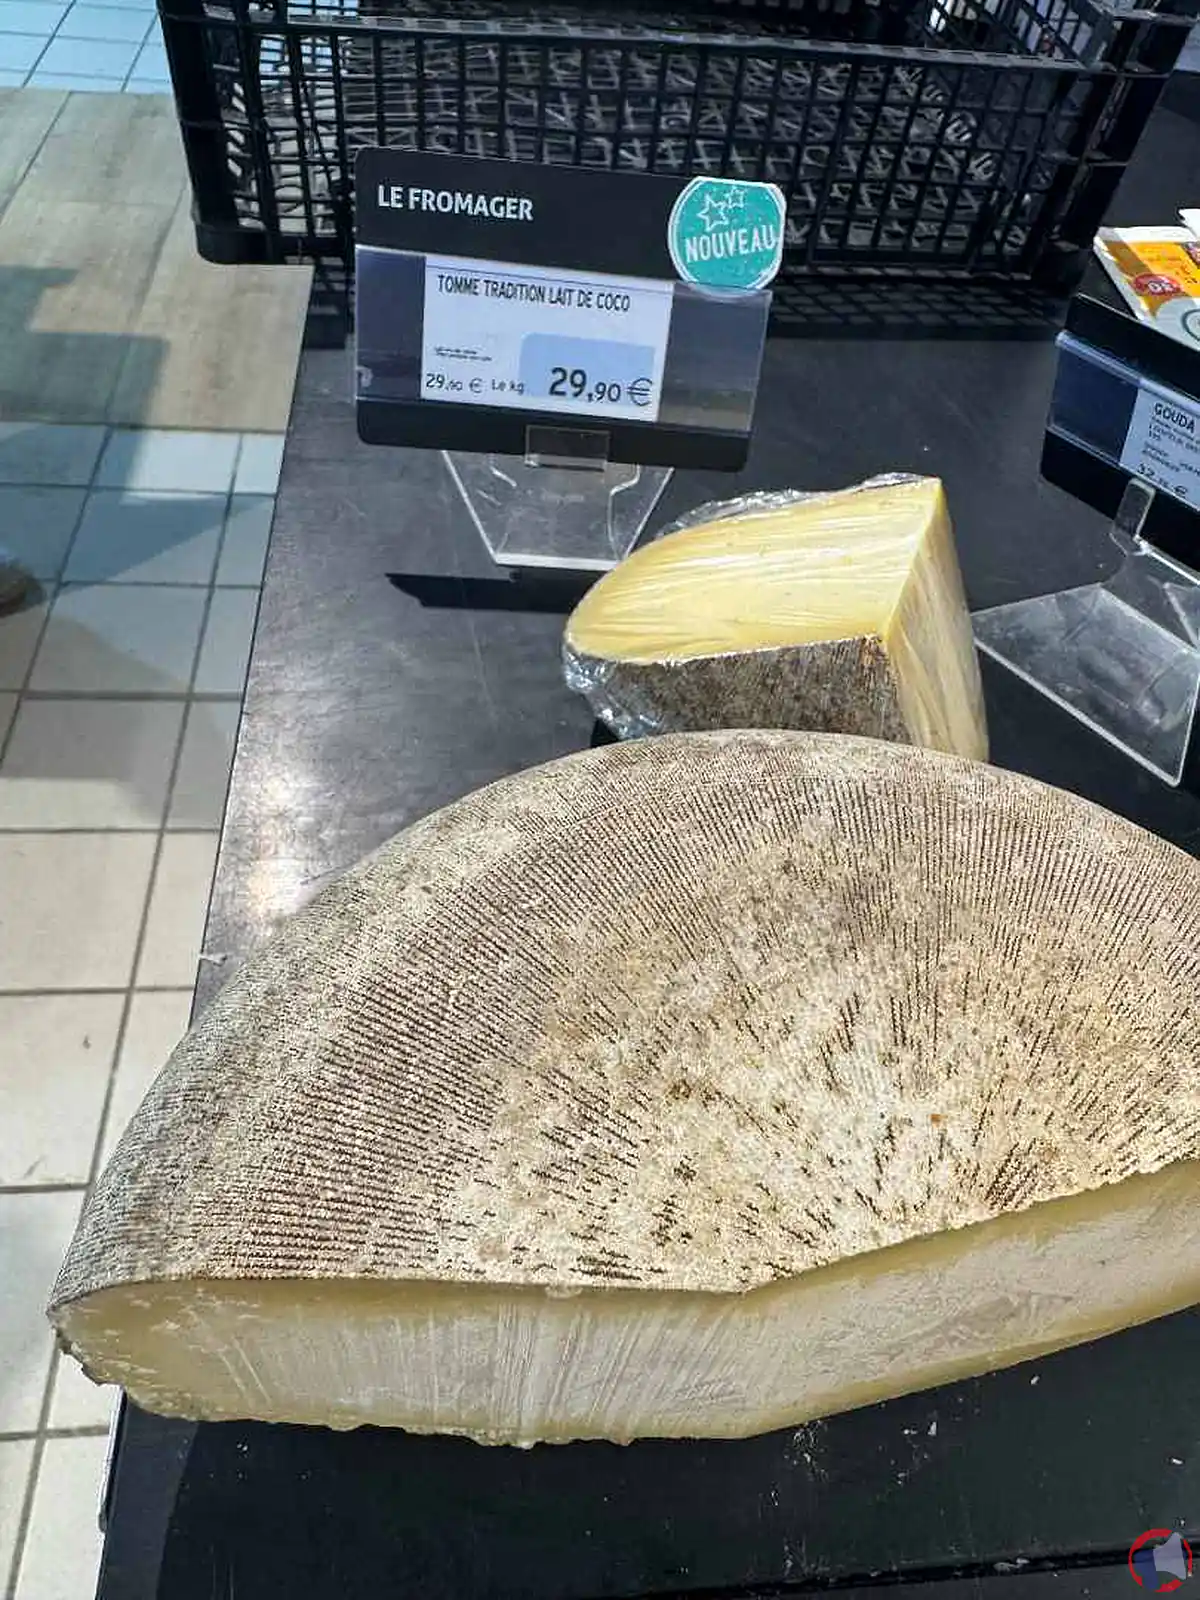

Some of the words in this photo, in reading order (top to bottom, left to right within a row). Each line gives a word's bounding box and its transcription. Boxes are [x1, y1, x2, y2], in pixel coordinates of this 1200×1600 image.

[377, 184, 404, 209] LE
[408, 187, 534, 221] FROMAGER
[685, 224, 777, 263] NOUVEAU
[437, 274, 480, 296] TOMME
[484, 279, 546, 303] TRADITION
[549, 286, 575, 306] LAIT
[577, 289, 593, 308] DE
[597, 292, 630, 312] COCO
[1154, 402, 1195, 434] GOUDA
